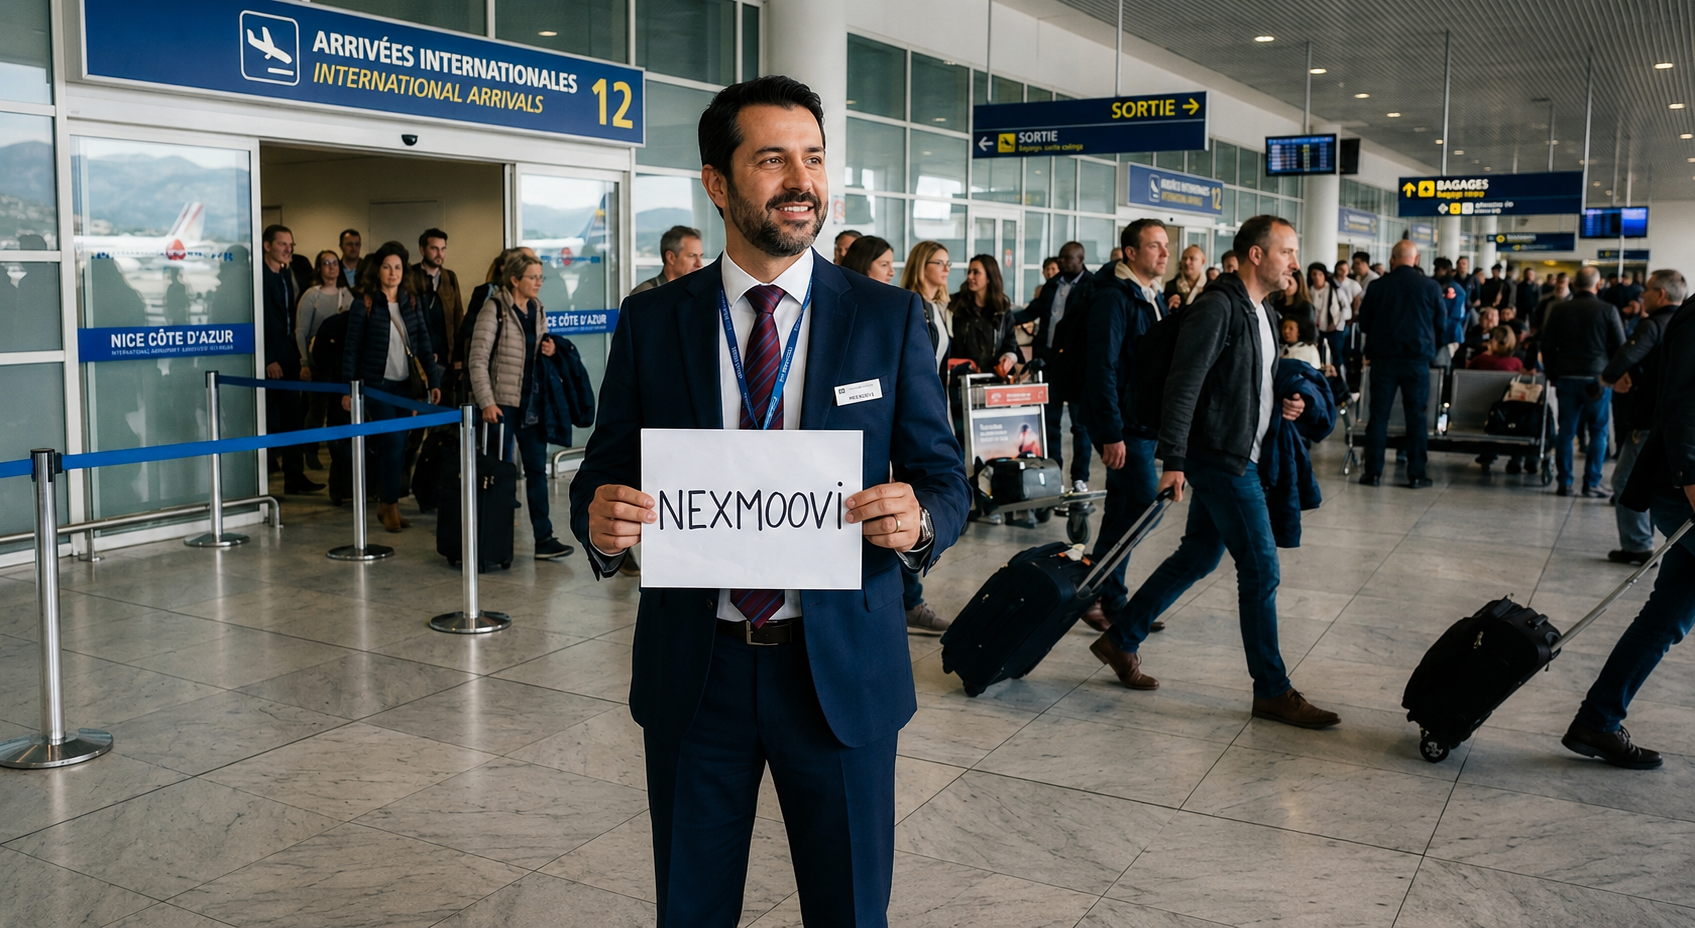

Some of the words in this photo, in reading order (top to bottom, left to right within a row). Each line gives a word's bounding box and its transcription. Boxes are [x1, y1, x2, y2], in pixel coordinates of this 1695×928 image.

[312, 29, 415, 68] ARRIVÉES
[420, 48, 578, 94] INTERNATIONALES
[313, 62, 463, 103] INTERNATIONAL
[466, 85, 544, 114] ARRIVALS
[591, 78, 634, 130] 12
[1112, 99, 1175, 118] SORTIE
[1018, 130, 1058, 143] SORTIE
[1436, 178, 1490, 191] BAGAGES
[1211, 187, 1222, 210] 12
[547, 315, 557, 327] CE
[580, 314, 607, 325] D'AZUR
[111, 332, 145, 348] NICE
[148, 328, 184, 346] CÔTE
[187, 329, 233, 344] D'AZUR
